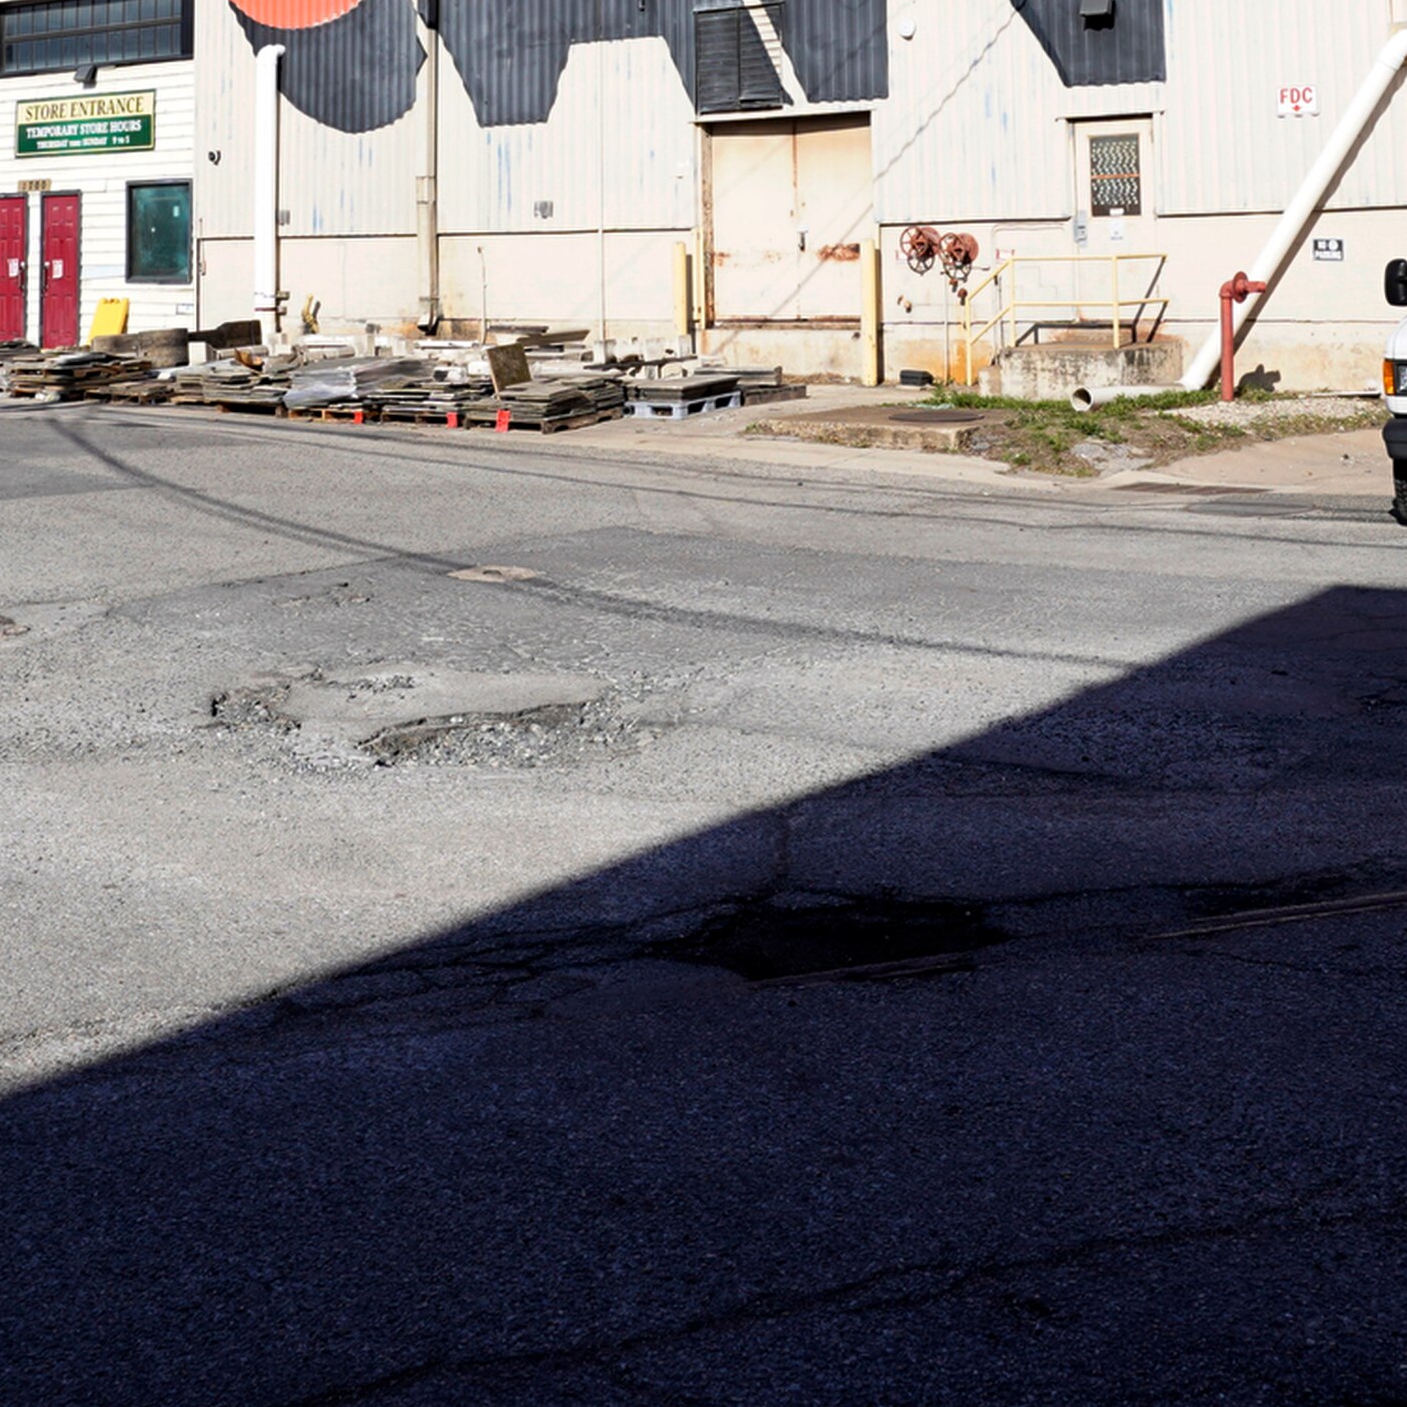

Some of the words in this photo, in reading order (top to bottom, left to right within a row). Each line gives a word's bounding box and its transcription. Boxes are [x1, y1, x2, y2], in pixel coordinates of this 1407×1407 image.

[1279, 87, 1313, 104] FDC
[25, 104, 68, 122] STORE
[70, 96, 144, 118] ENTRANCE
[26, 124, 79, 139] TEMPORARY
[80, 122, 109, 135] STORE
[110, 119, 142, 133] HOURS
